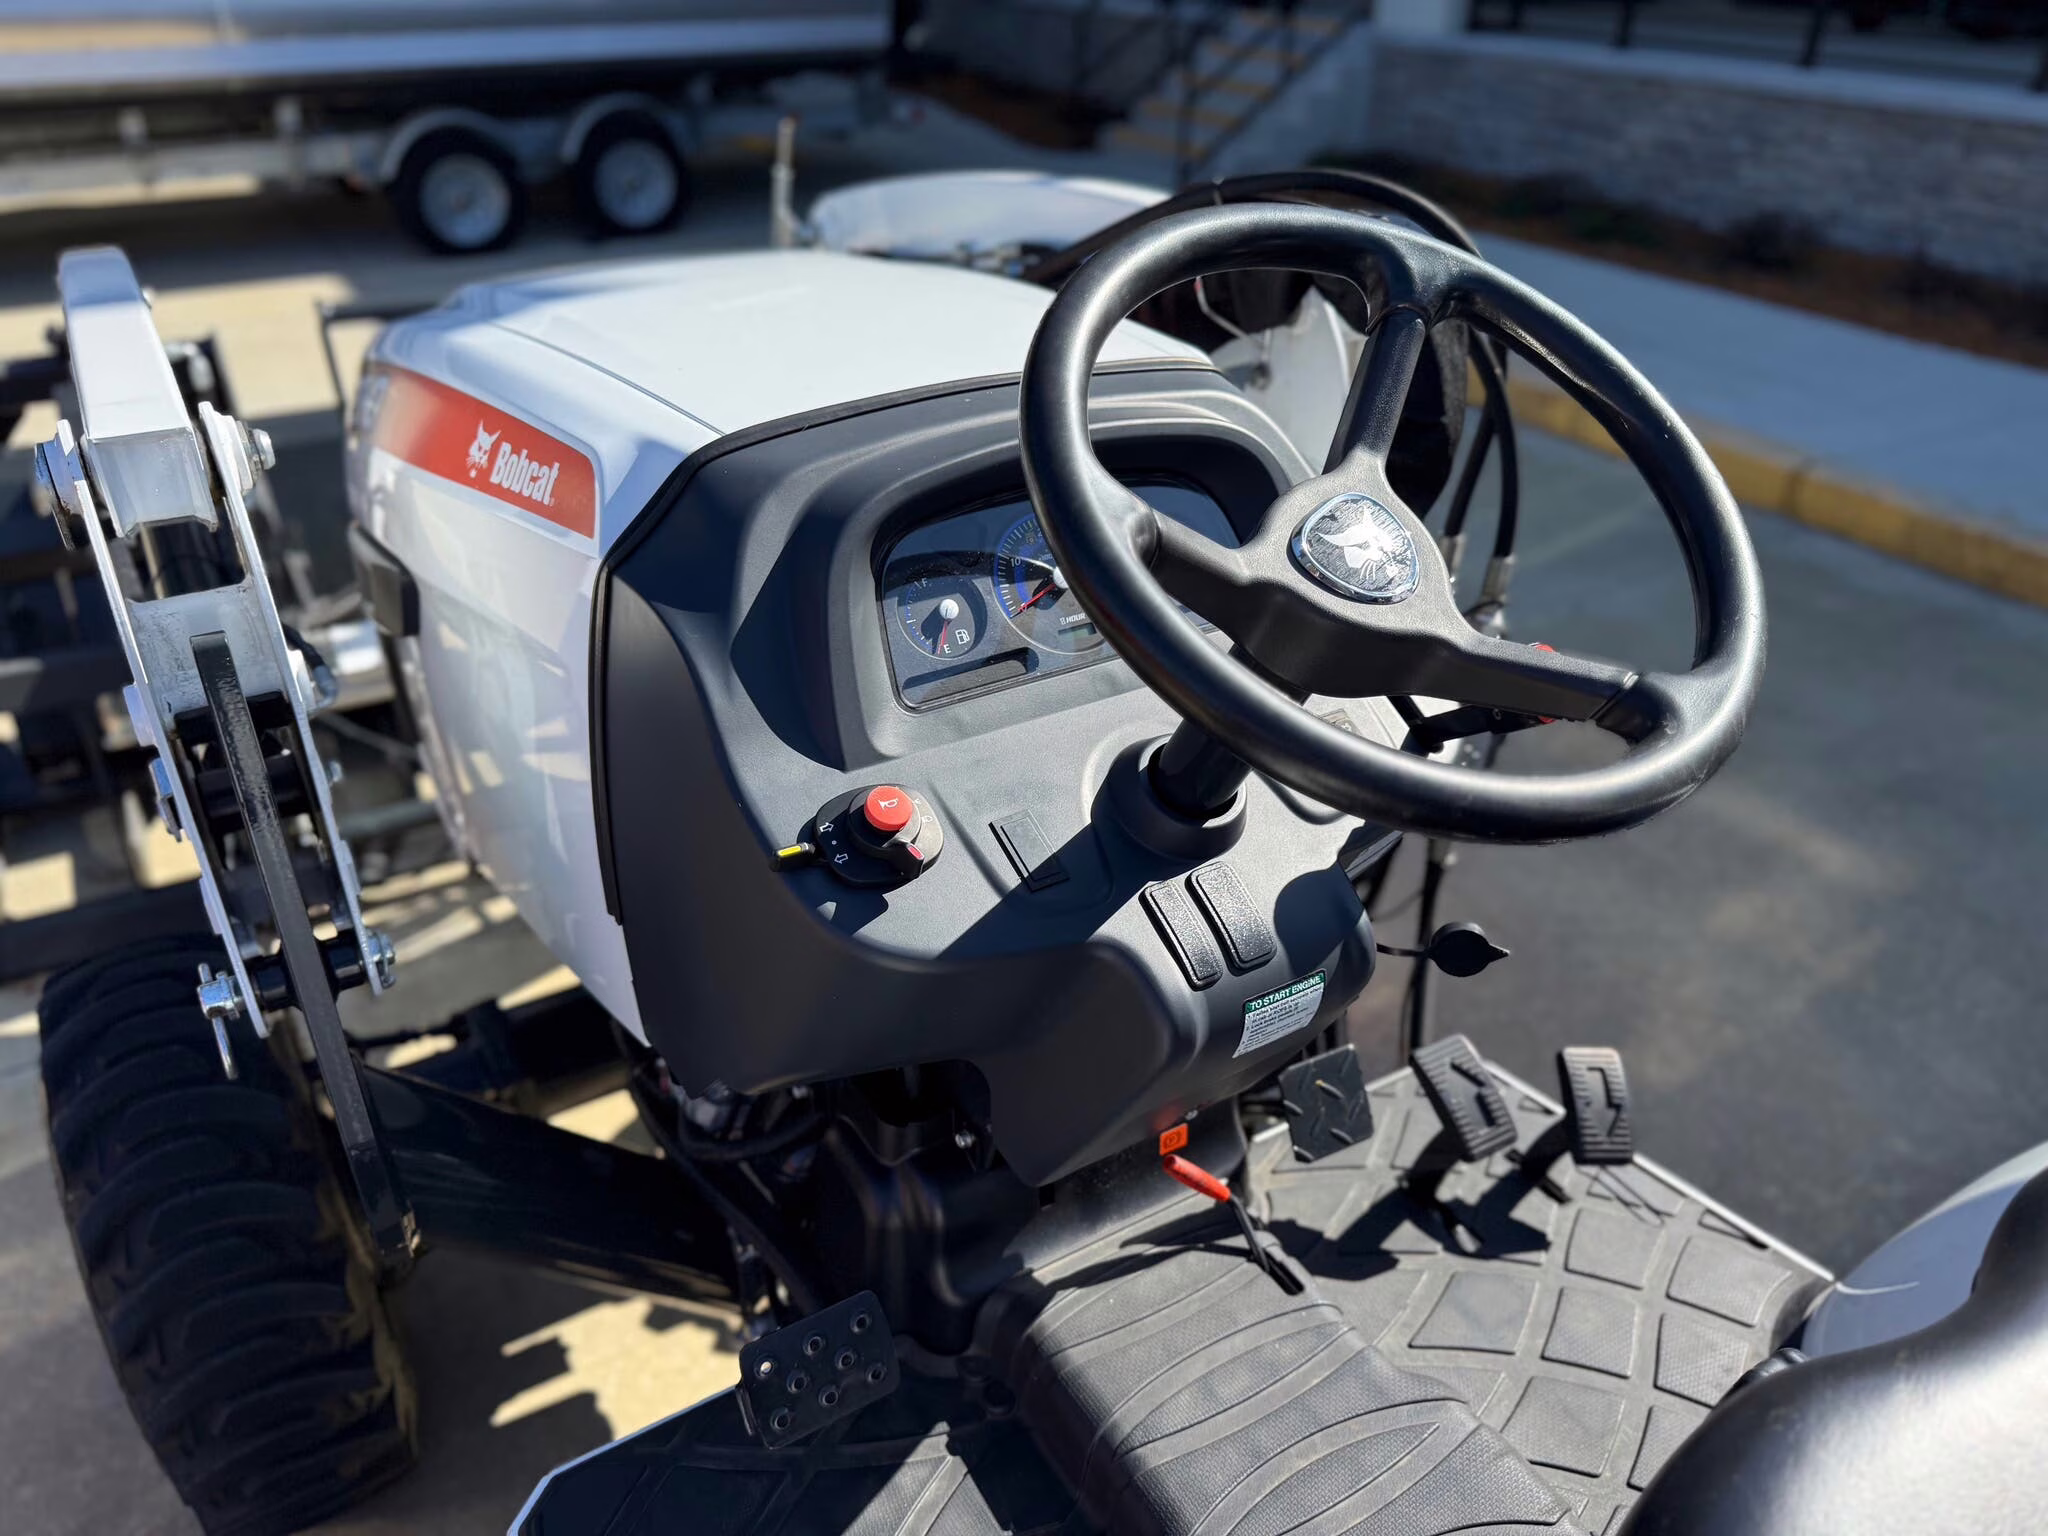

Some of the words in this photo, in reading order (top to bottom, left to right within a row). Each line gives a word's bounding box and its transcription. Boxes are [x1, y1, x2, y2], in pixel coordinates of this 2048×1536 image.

[490, 441, 560, 506] Bobcat
[1010, 557, 1021, 568] 10
[943, 643, 952, 654] E
[1250, 1001, 1261, 1010] TO
[1264, 988, 1291, 1006] START
[1292, 976, 1321, 994] ENGINE
